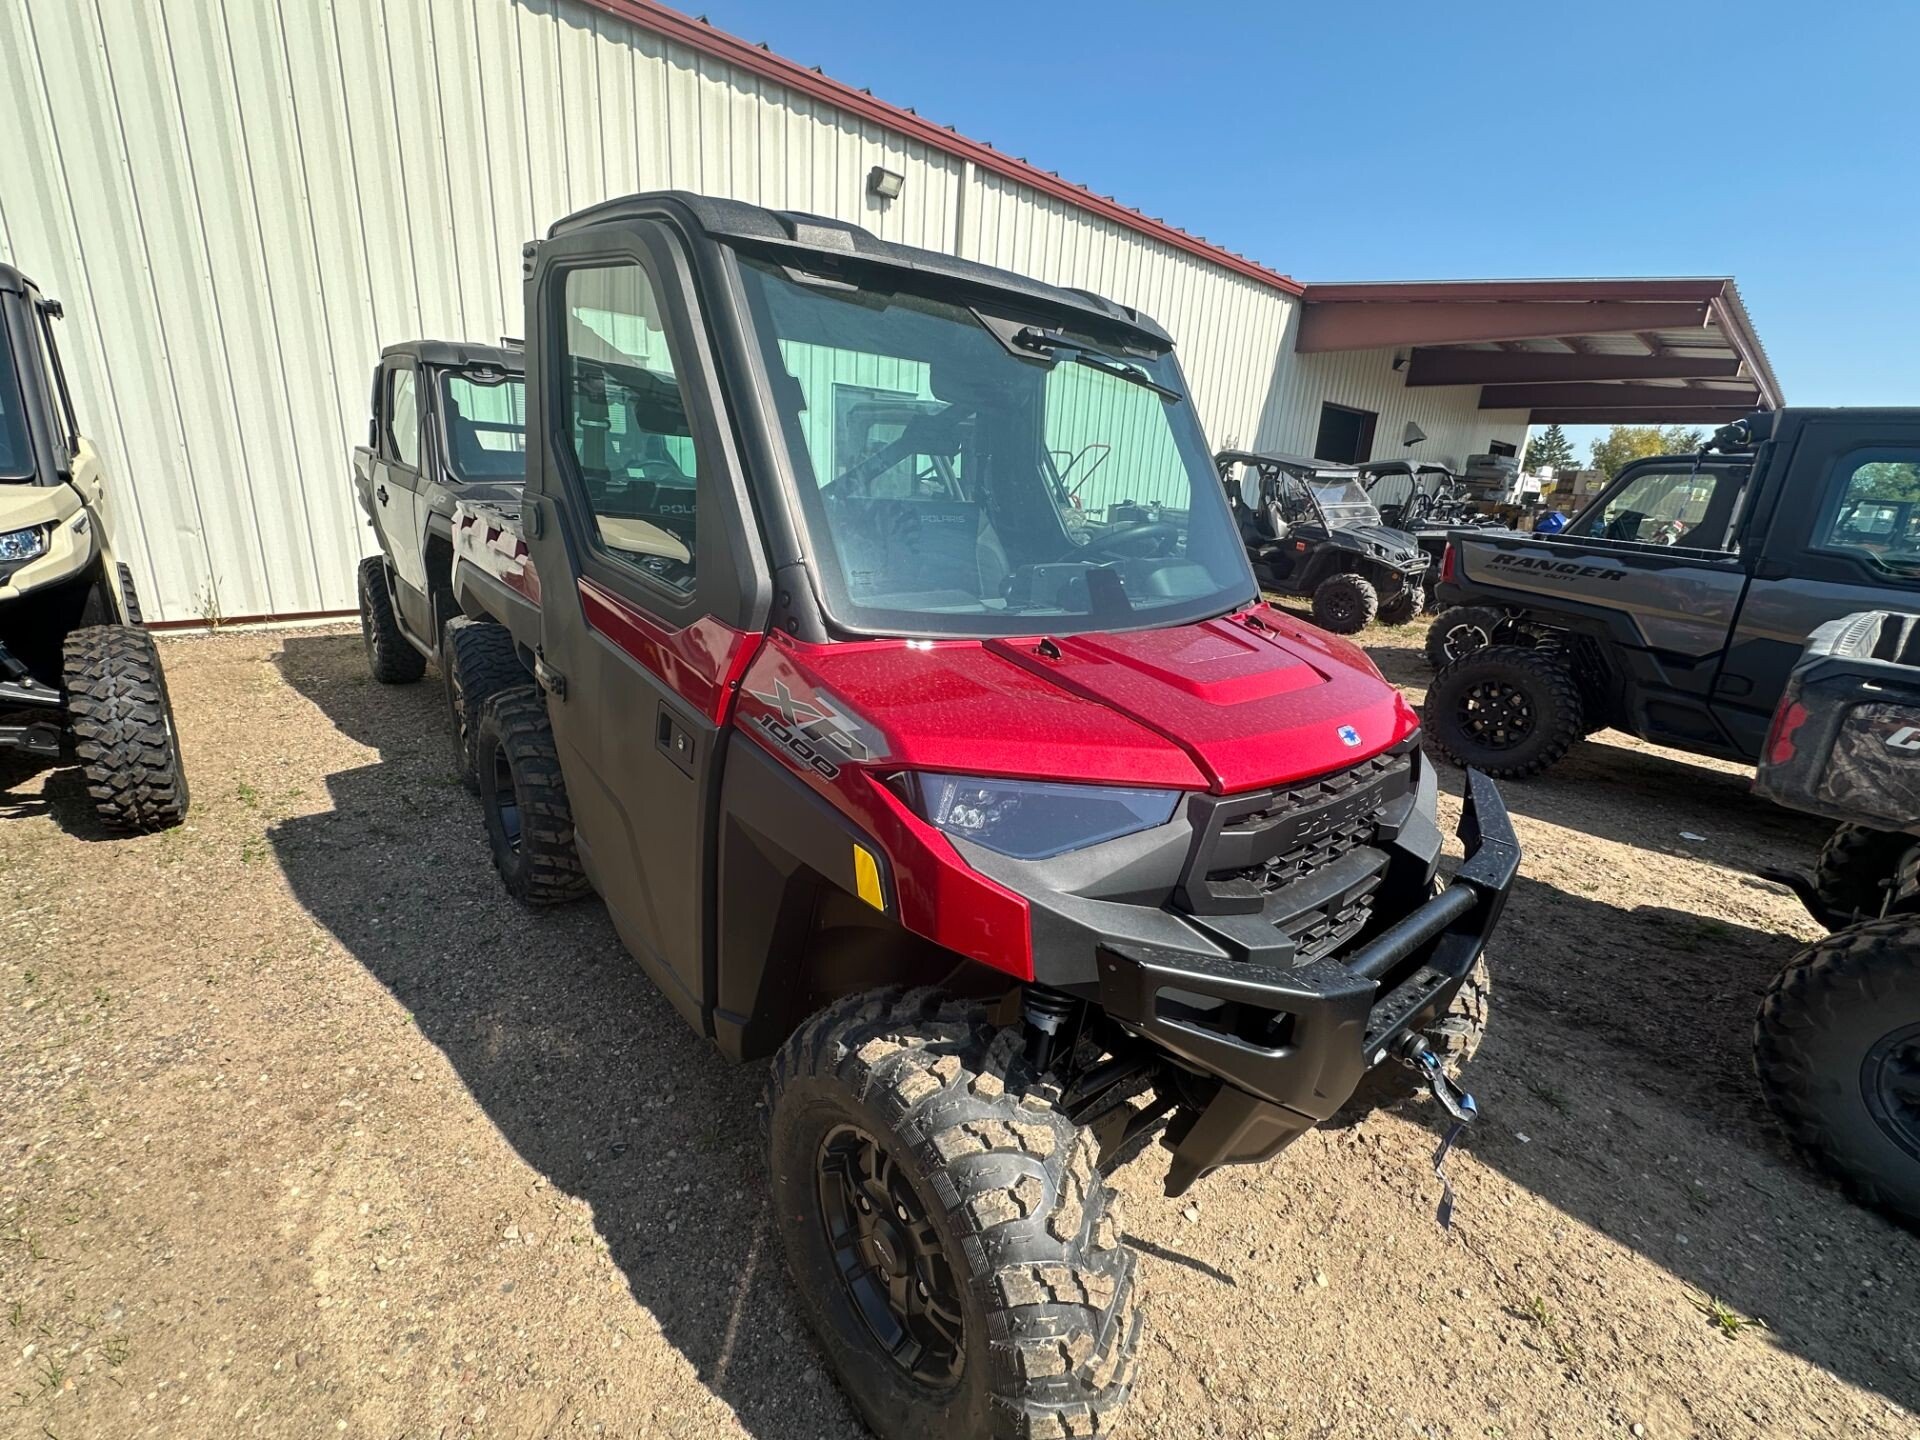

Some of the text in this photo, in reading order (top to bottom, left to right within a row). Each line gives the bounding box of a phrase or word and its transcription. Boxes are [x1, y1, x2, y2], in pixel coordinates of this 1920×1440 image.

[920, 514, 967, 524] POLARIS
[1491, 553, 1628, 582] RANGER
[751, 677, 870, 763] XP
[759, 712, 842, 781] 1000
[1291, 786, 1385, 846] POLARIS
